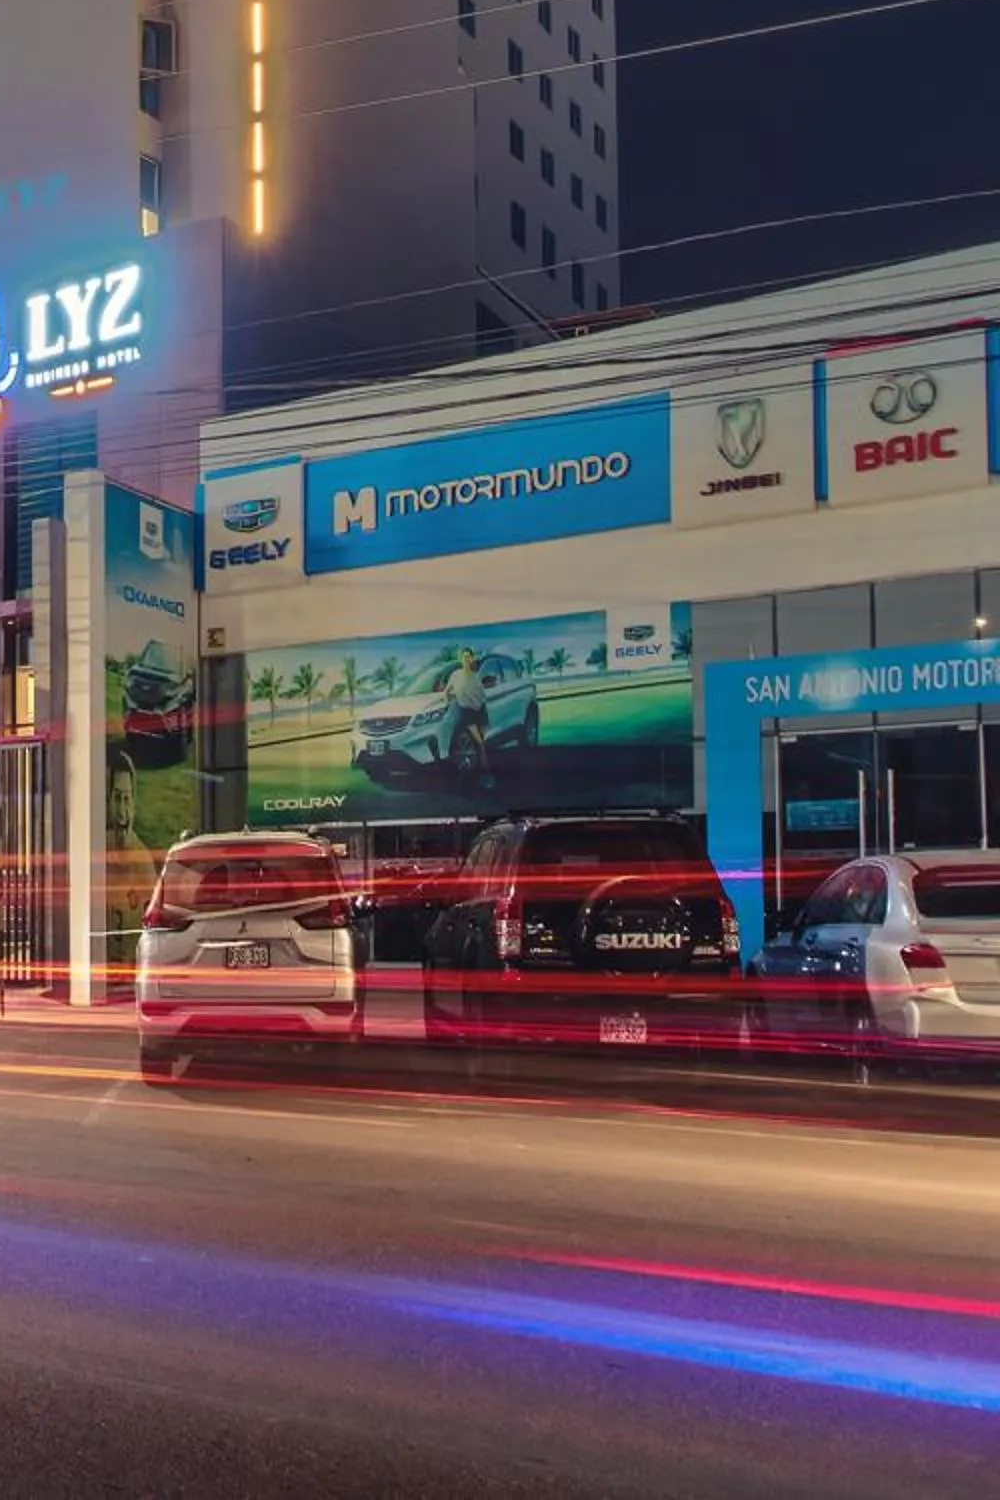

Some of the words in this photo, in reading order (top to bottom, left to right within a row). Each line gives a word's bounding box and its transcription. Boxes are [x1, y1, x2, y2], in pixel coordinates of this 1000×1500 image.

[26, 264, 142, 361] LYZ
[97, 347, 141, 370] HOTEL
[854, 427, 959, 473] BAIC
[386, 451, 630, 519] MOTORMUNDO
[700, 471, 781, 496] JINBEI
[209, 537, 292, 570] GEELY
[615, 643, 663, 659] GEELY
[745, 674, 791, 704] SAN
[263, 794, 347, 811] COOLRAY
[595, 932, 682, 950] SUZUKI
